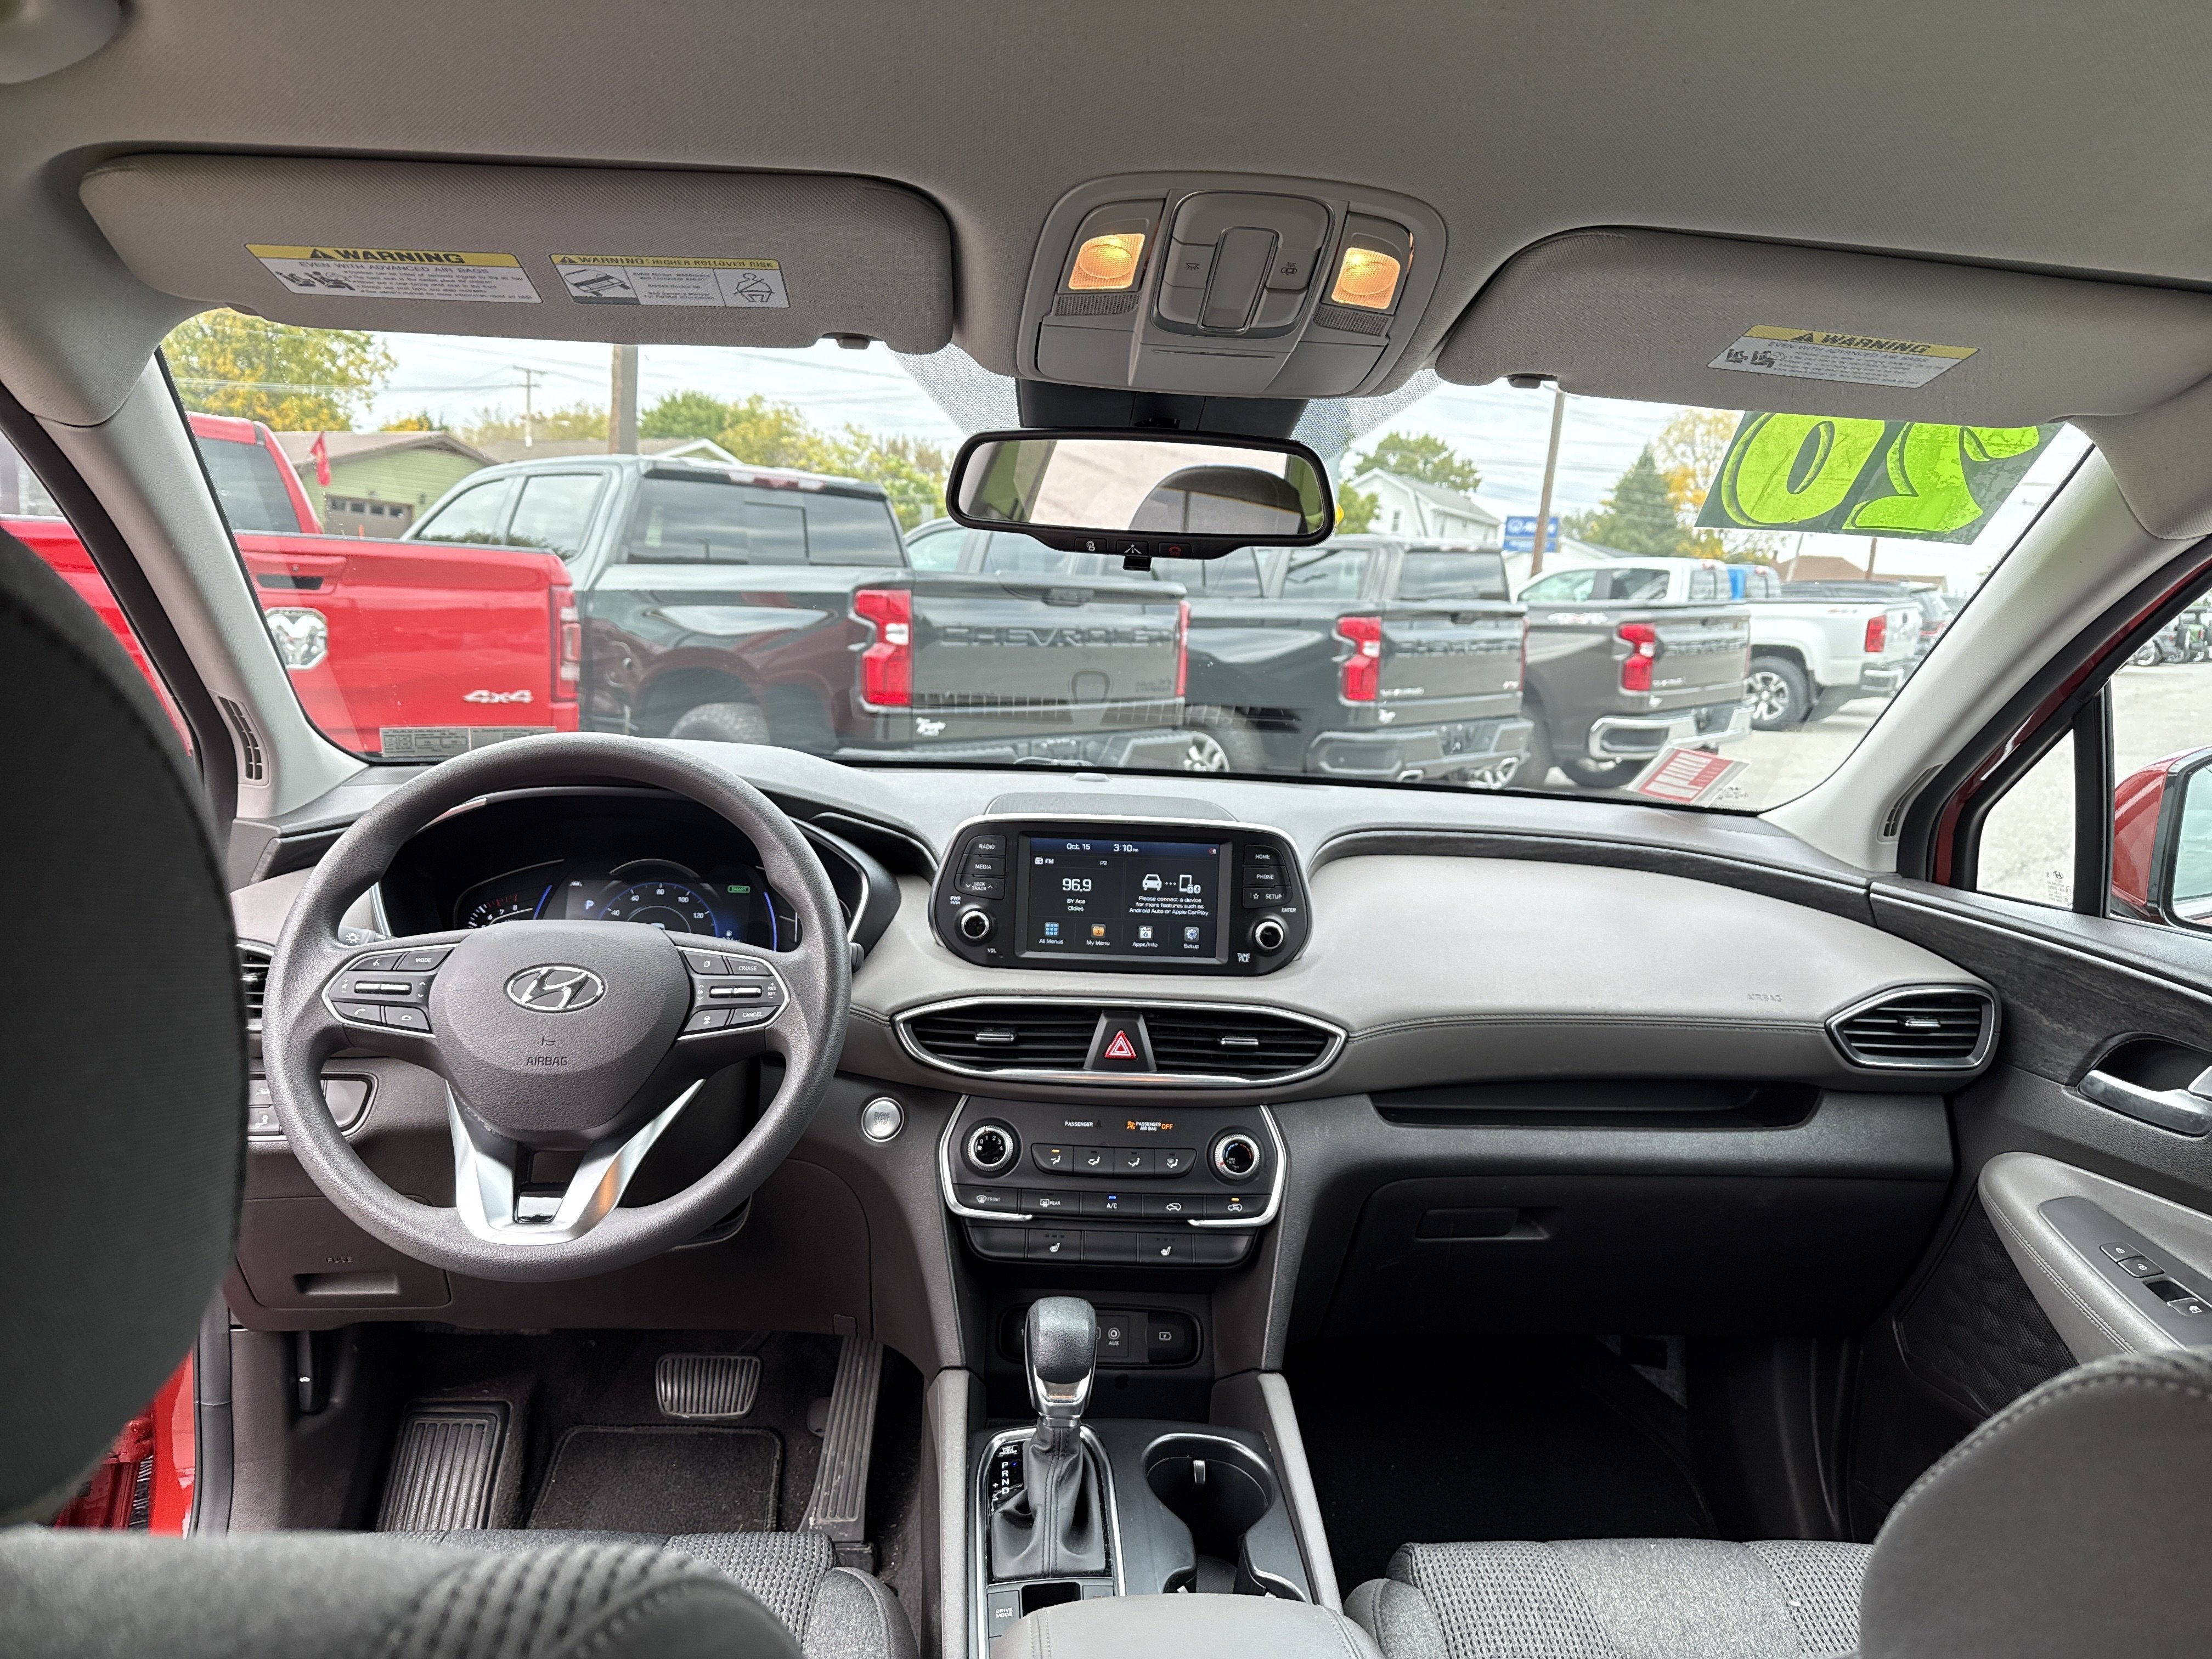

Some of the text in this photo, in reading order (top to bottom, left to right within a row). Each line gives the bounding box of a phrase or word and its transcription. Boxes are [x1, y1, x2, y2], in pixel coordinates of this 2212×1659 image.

[334, 250, 466, 263] WARNING
[1821, 334, 1931, 353] WARNING
[1114, 843, 1132, 852] 3:10
[1062, 878, 1092, 892] 96.9
[585, 900, 594, 910] P
[1747, 992, 1782, 1003] AIRBAG
[526, 1055, 568, 1068] AIRBAG
